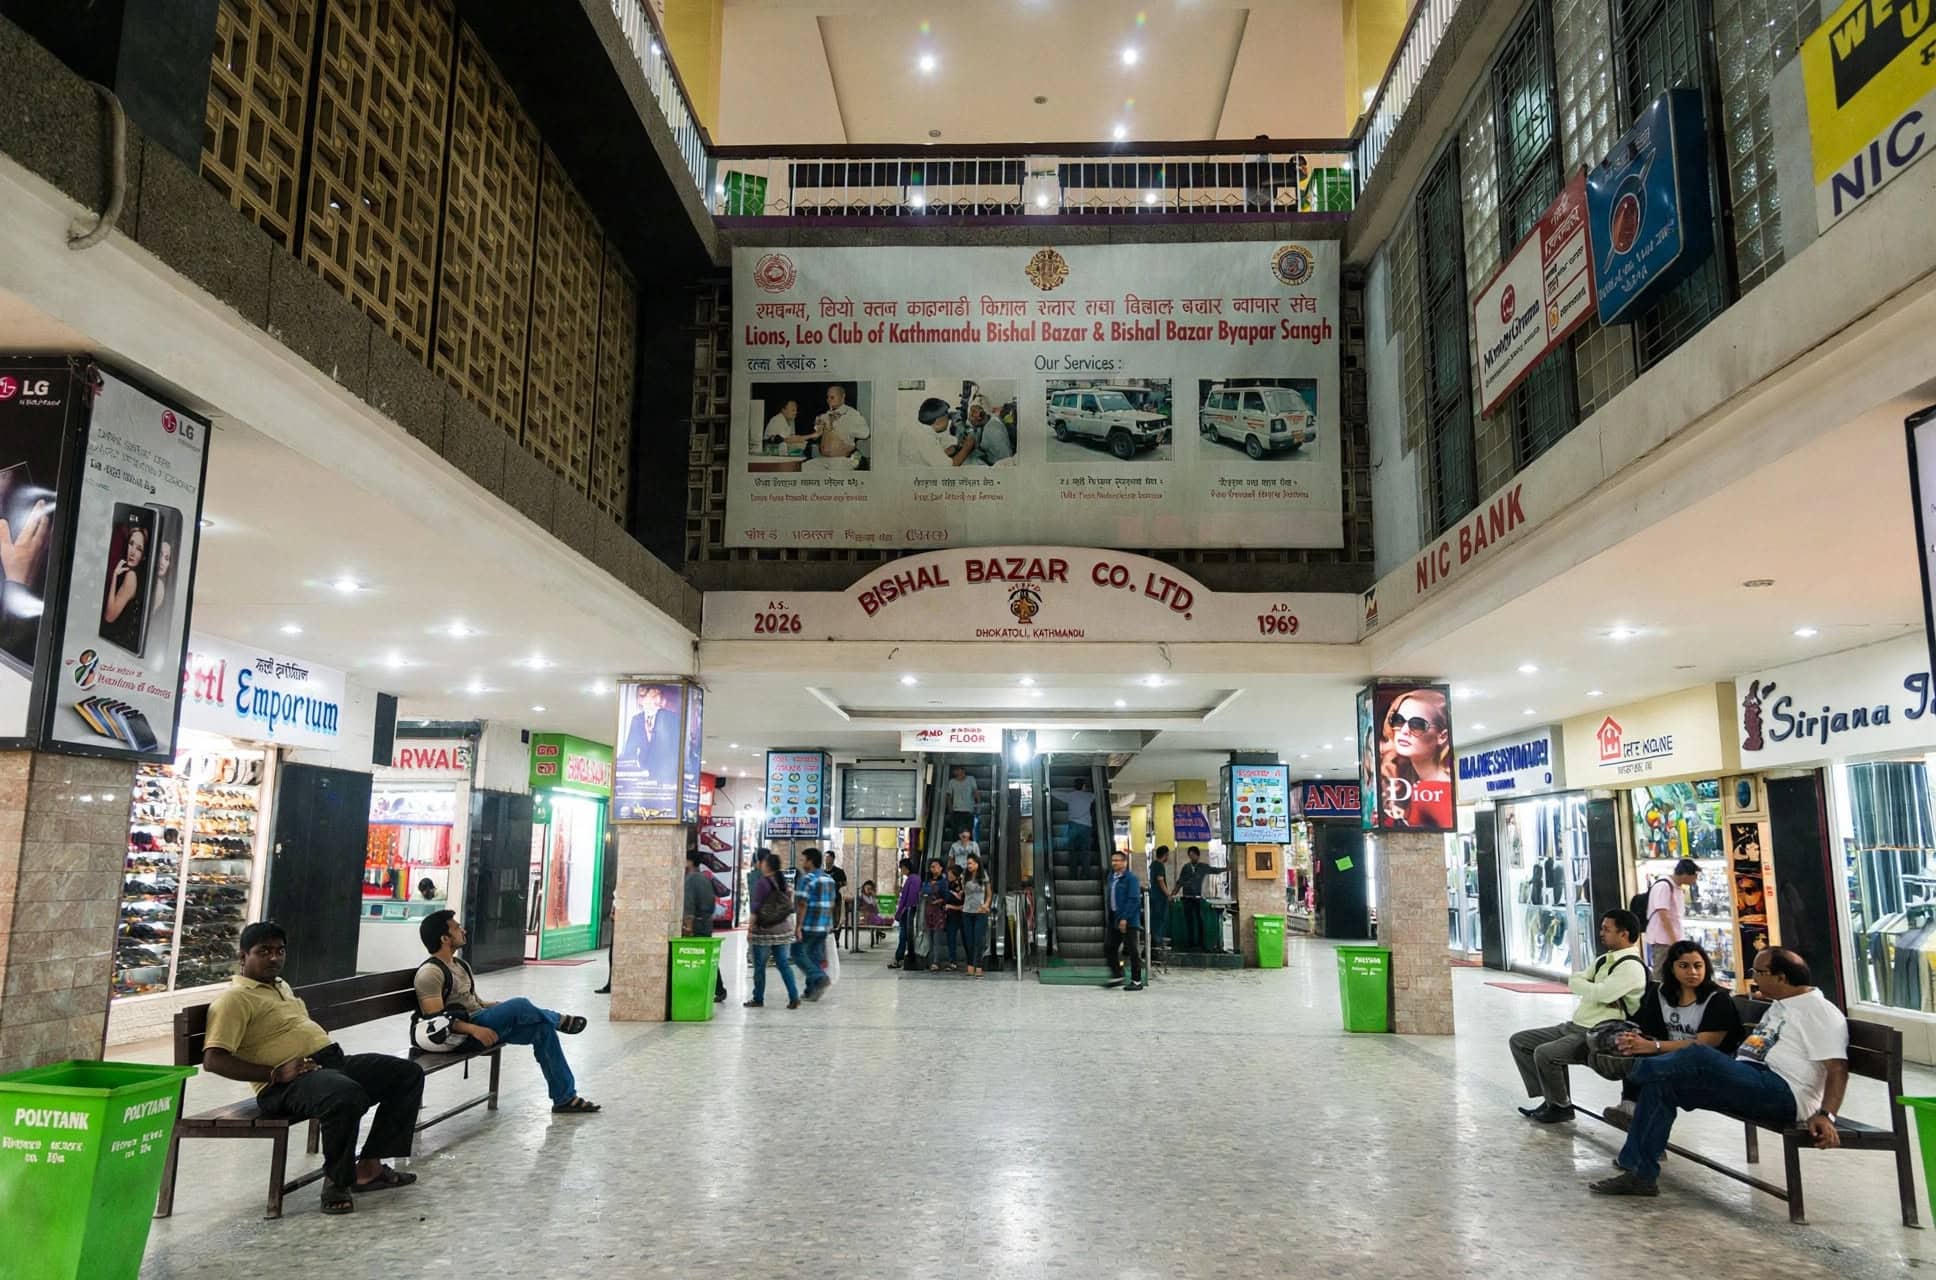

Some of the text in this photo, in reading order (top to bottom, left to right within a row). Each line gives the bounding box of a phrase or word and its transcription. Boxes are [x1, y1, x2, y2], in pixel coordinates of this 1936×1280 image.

[1832, 111, 1925, 216] NIC
[745, 317, 1332, 348] Lions, Leo Club of Kathmandu Bishal Bazar & Bishal Bazar Byapar Sangh
[1034, 354, 1060, 370] Our
[22, 380, 50, 396] LG
[179, 420, 194, 440] LG
[1416, 483, 1525, 594] NIC BANK
[857, 557, 1193, 620] BISHAL BAZAR CO. LTD.
[753, 613, 802, 634] 2026
[1033, 628, 1085, 638] KATHMANDU
[1257, 615, 1299, 635] 1969
[236, 668, 339, 732] Emporium
[1769, 695, 1890, 744] Sirjana
[949, 734, 985, 743] FLOOR
[1388, 777, 1444, 802] Dior
[15, 1108, 90, 1130] POLYTANK
[122, 1096, 173, 1124] POLYTANK
